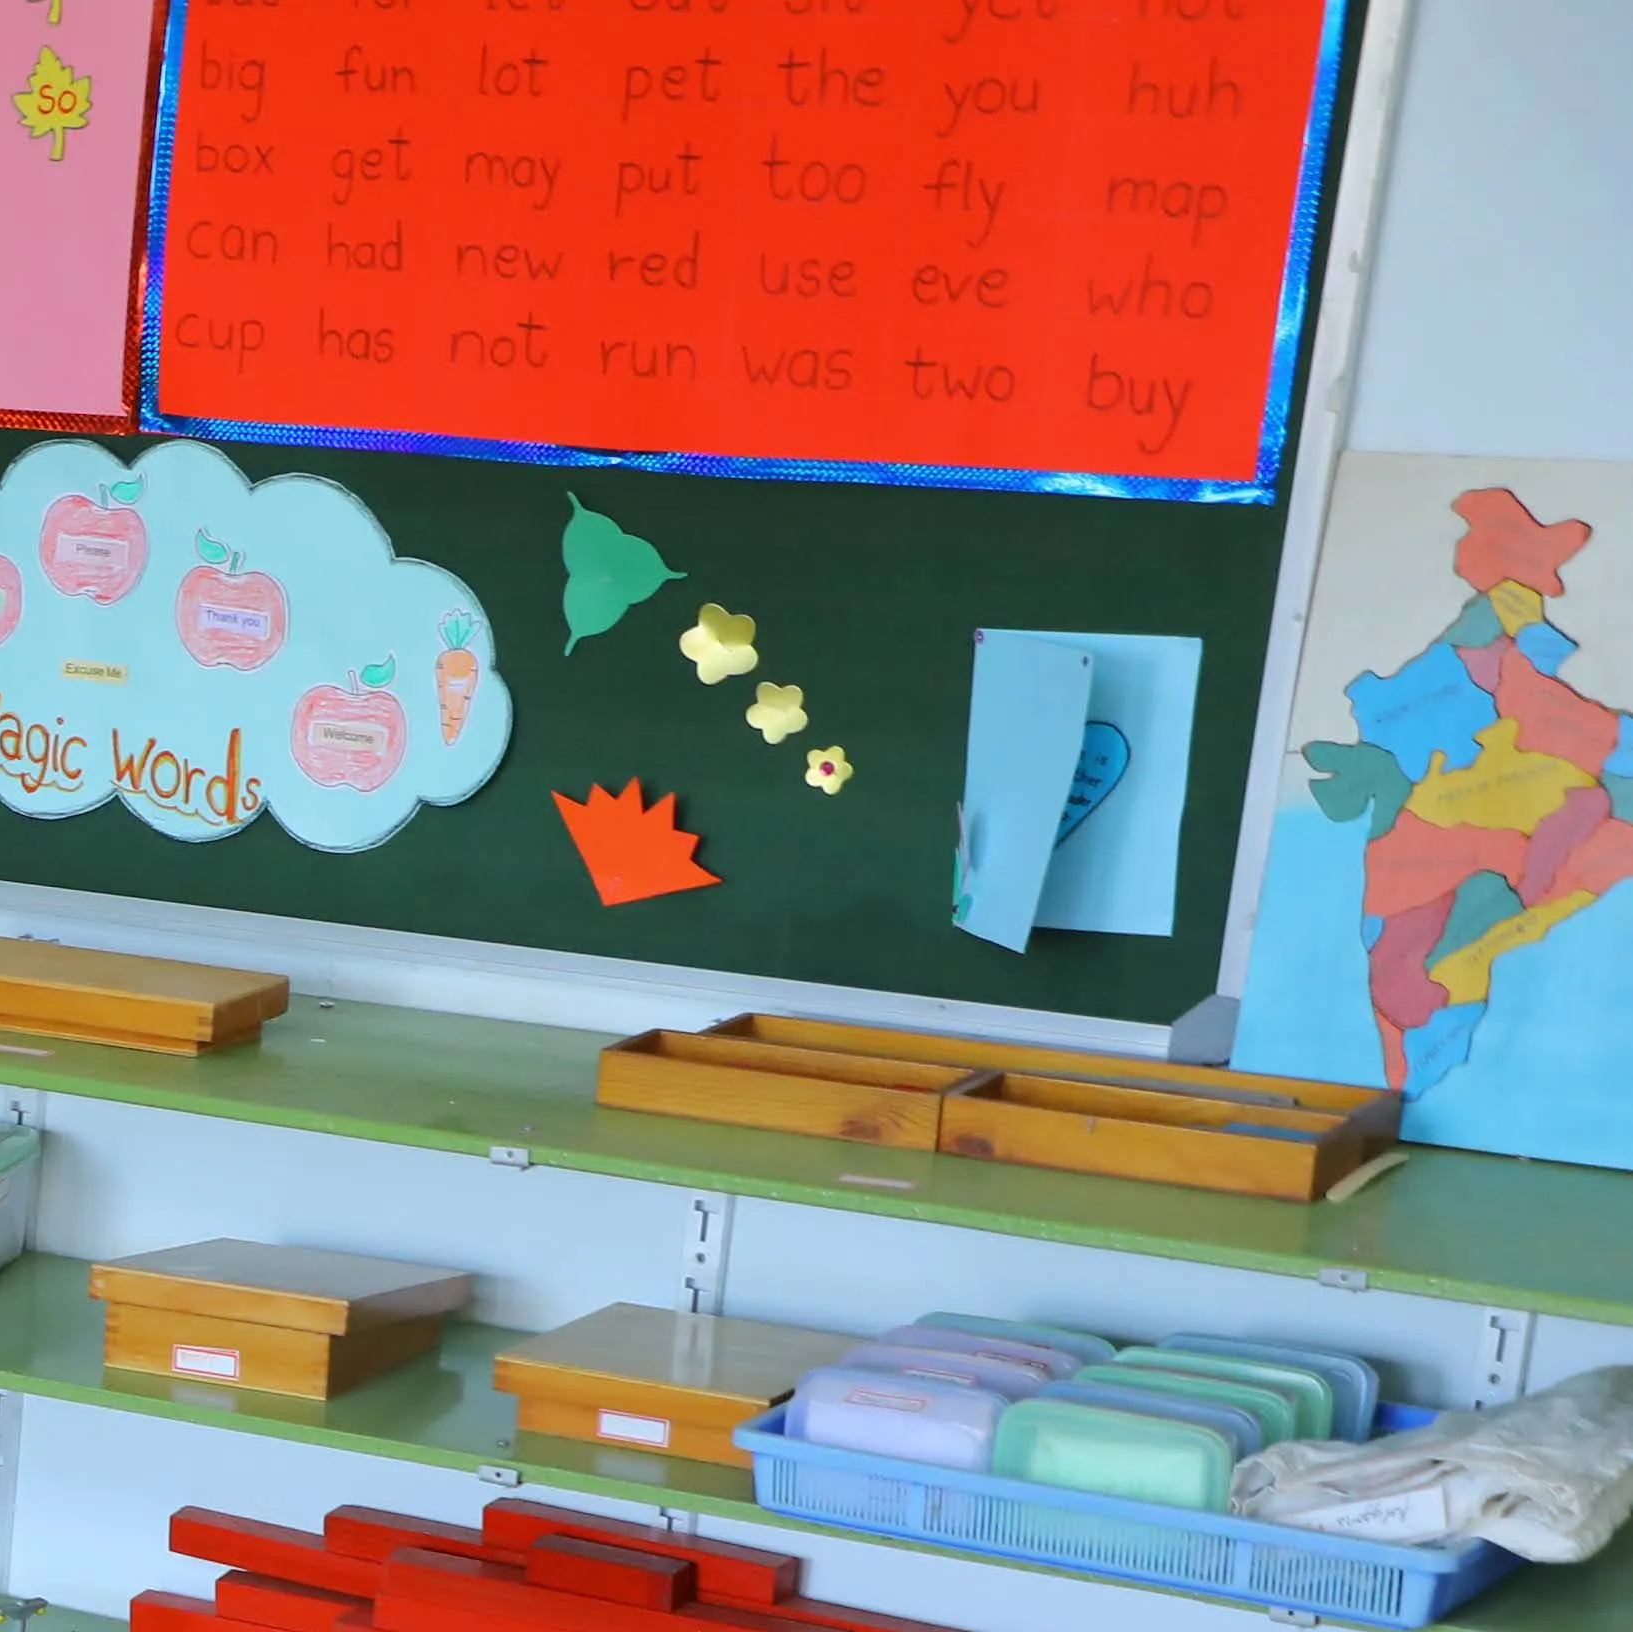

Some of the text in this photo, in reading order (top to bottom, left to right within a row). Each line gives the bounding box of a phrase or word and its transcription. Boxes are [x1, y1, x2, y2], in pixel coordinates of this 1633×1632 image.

[199, 41, 1241, 138] big fun lot pet the you huh
[196, 127, 1229, 249] box get may put too fly map
[186, 219, 1214, 321] can had new red use eve who
[176, 308, 1193, 455] cup has not run was two buy
[76, 543, 111, 559] Please
[206, 609, 260, 628] Thank you
[64, 662, 104, 677] Excuse
[112, 727, 262, 823] Words
[322, 727, 375, 745] Welcome
